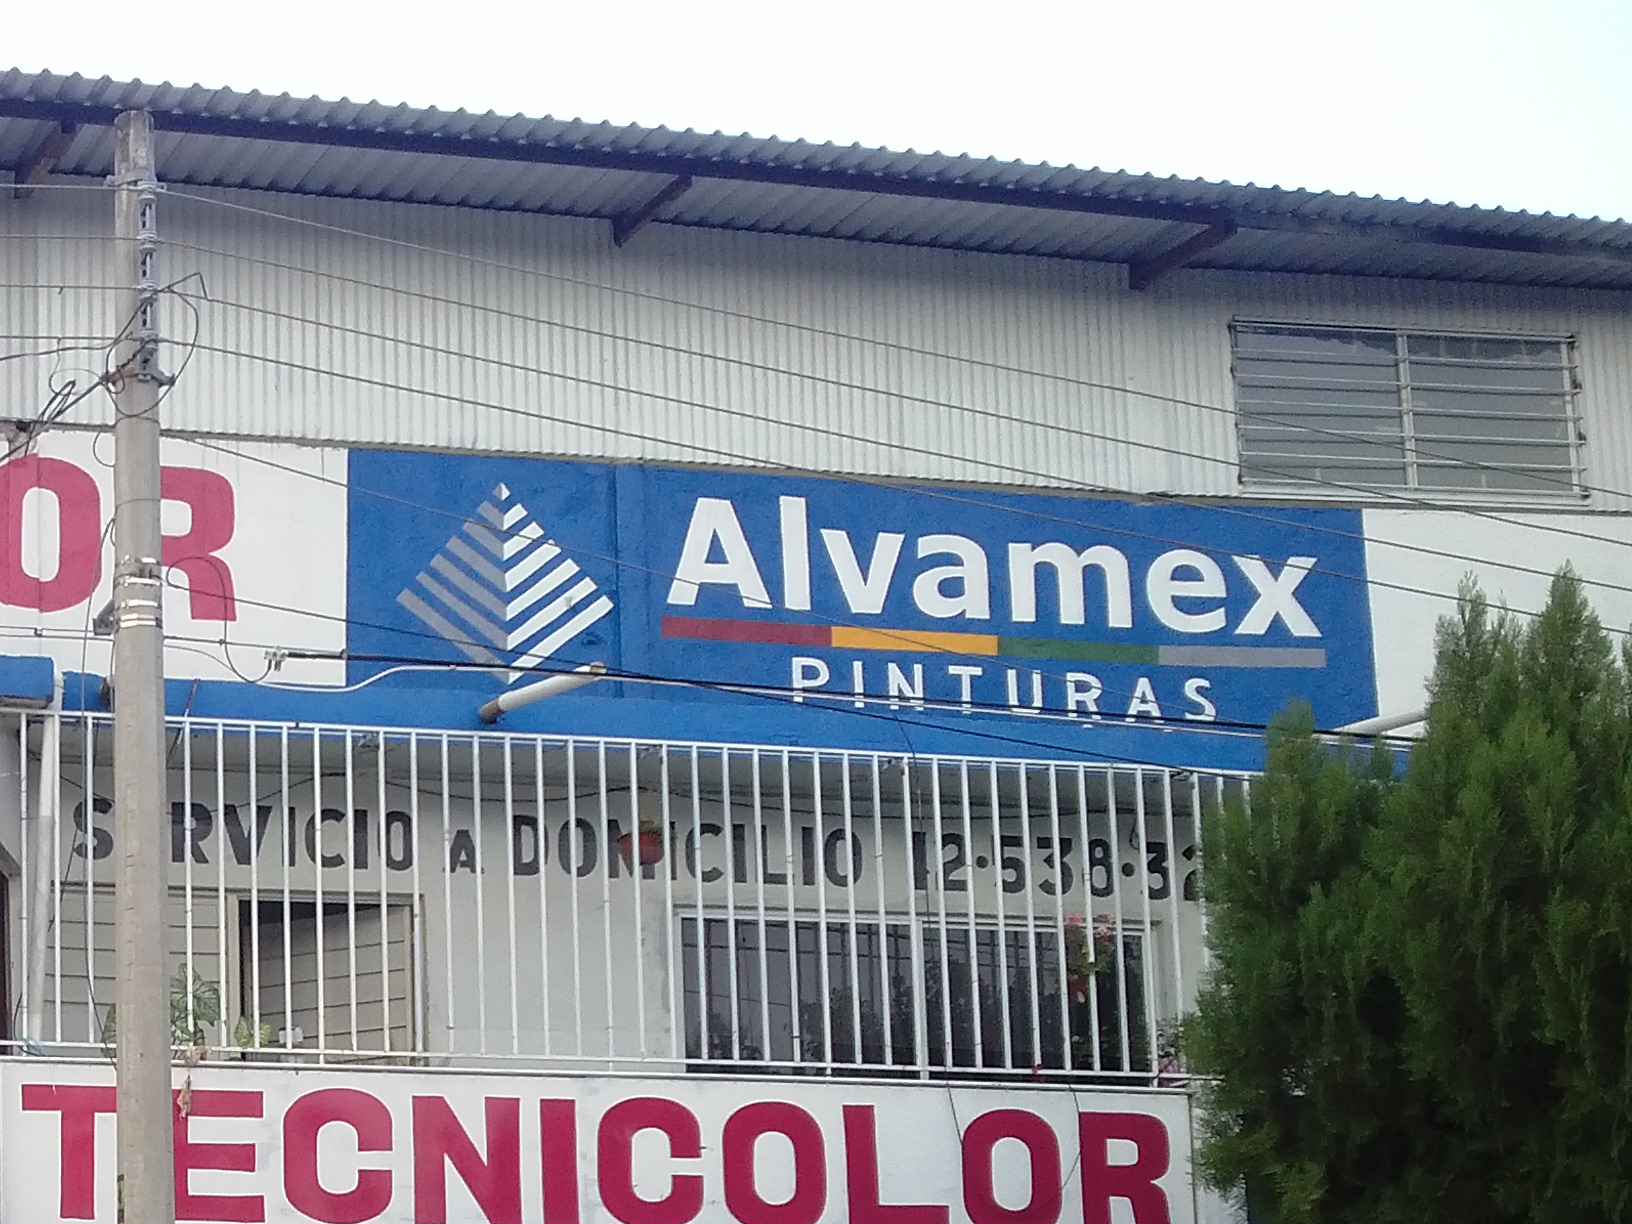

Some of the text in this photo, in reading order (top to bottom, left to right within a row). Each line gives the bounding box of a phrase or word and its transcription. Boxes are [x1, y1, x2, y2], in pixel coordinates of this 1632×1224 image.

[665, 495, 1324, 637] Alvamex
[790, 656, 1217, 732] PINTURAS
[72, 798, 414, 871] SRVICIO
[443, 827, 485, 875] A
